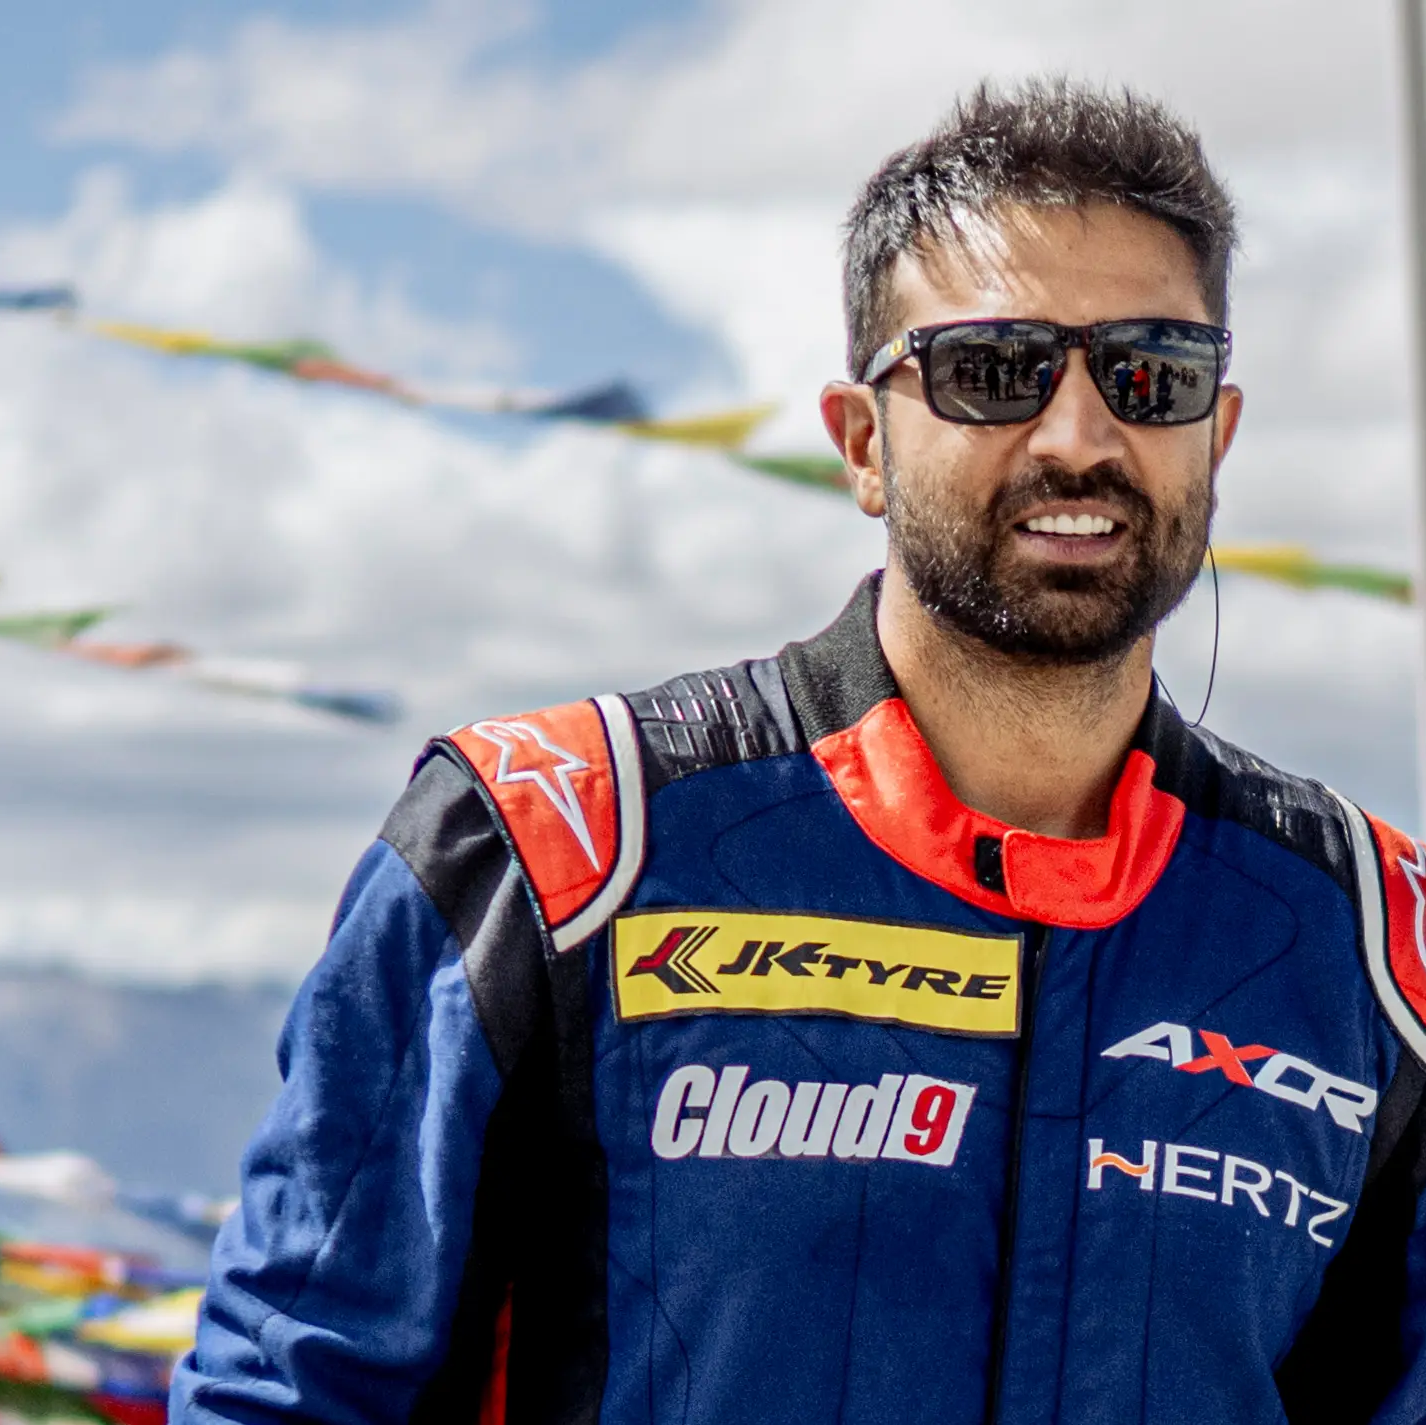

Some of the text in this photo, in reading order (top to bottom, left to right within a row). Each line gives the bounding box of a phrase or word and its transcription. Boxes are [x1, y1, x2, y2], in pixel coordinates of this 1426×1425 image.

[651, 1063, 978, 1168] Cloud9
[1100, 1021, 1378, 1134] AXOR
[1086, 1137, 1352, 1249] HERTZ
